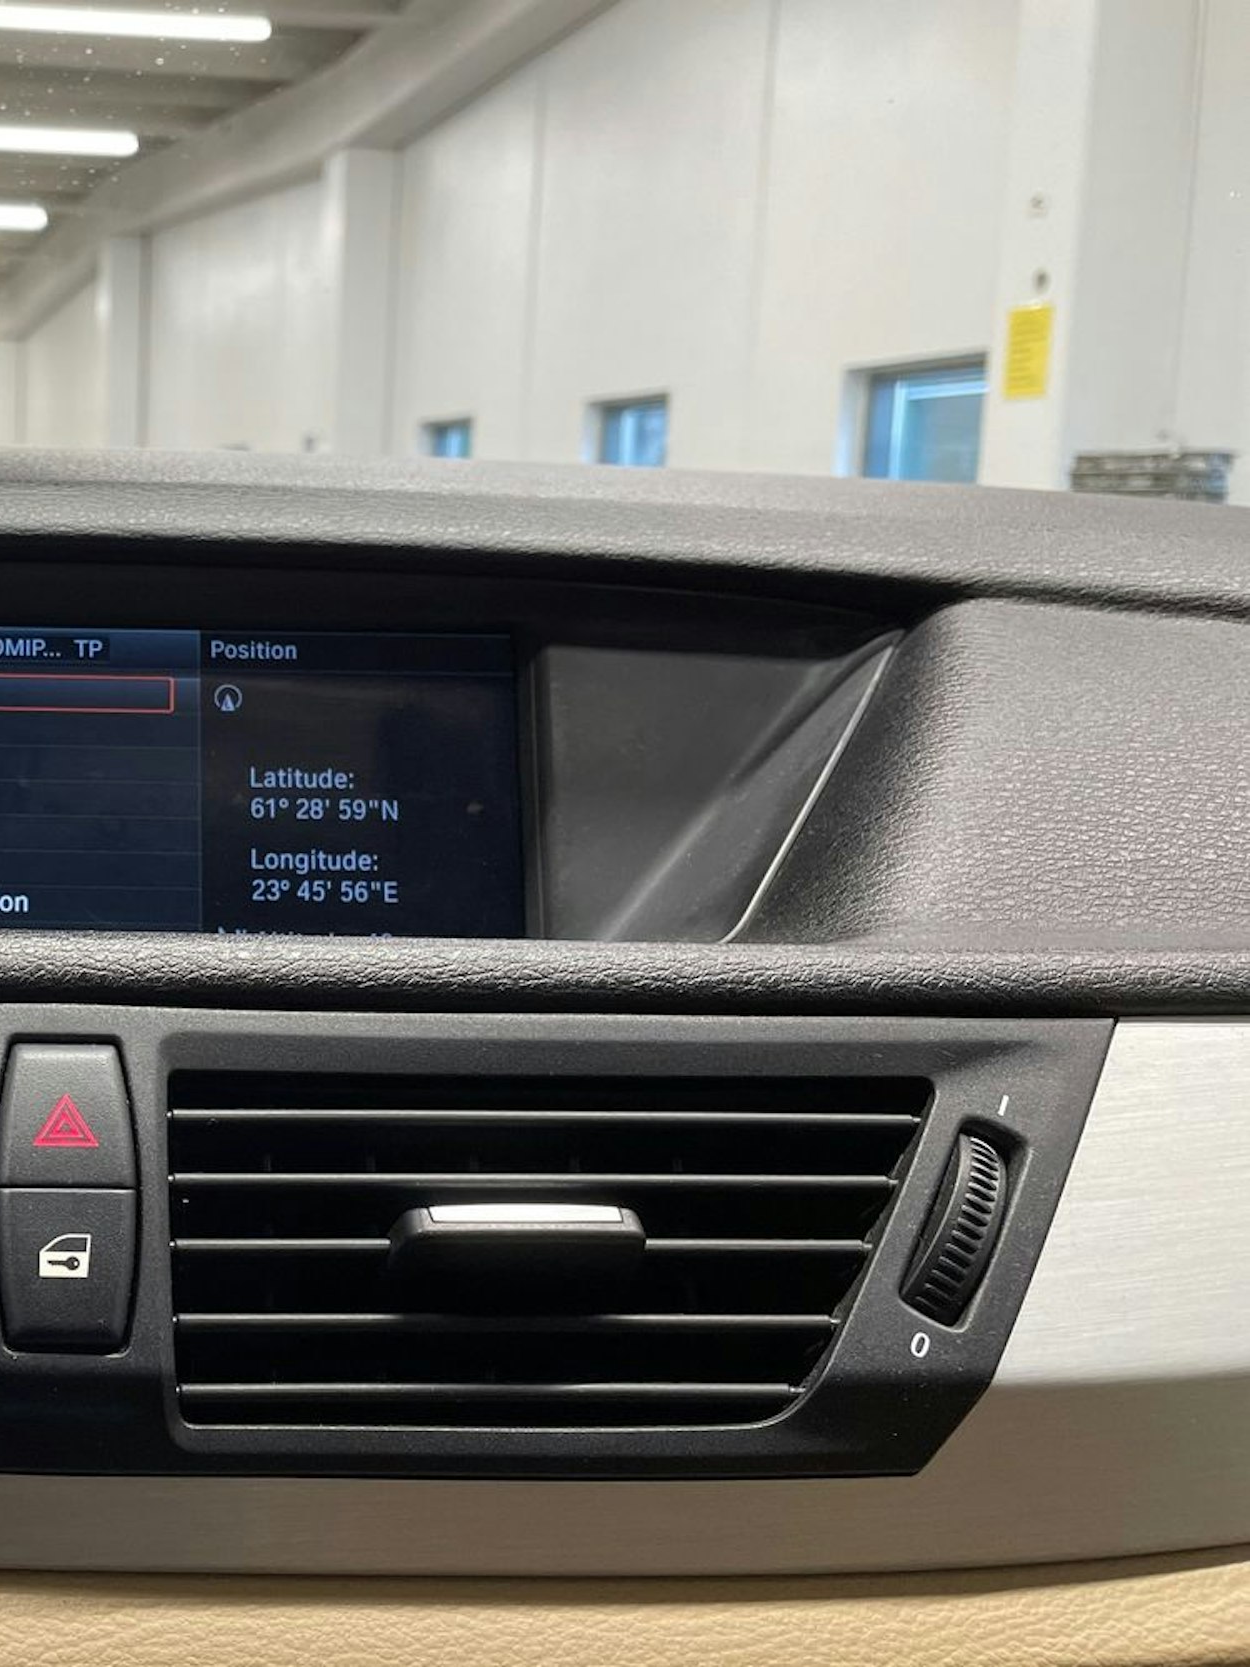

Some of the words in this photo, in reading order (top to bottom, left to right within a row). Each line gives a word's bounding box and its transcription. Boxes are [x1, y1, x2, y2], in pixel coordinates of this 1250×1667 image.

[74, 639, 103, 658] TP
[210, 639, 298, 660] Position
[250, 767, 354, 789] Latitude:
[296, 800, 331, 820] 28'
[251, 849, 378, 875] Longitude:
[297, 881, 332, 902] 45'
